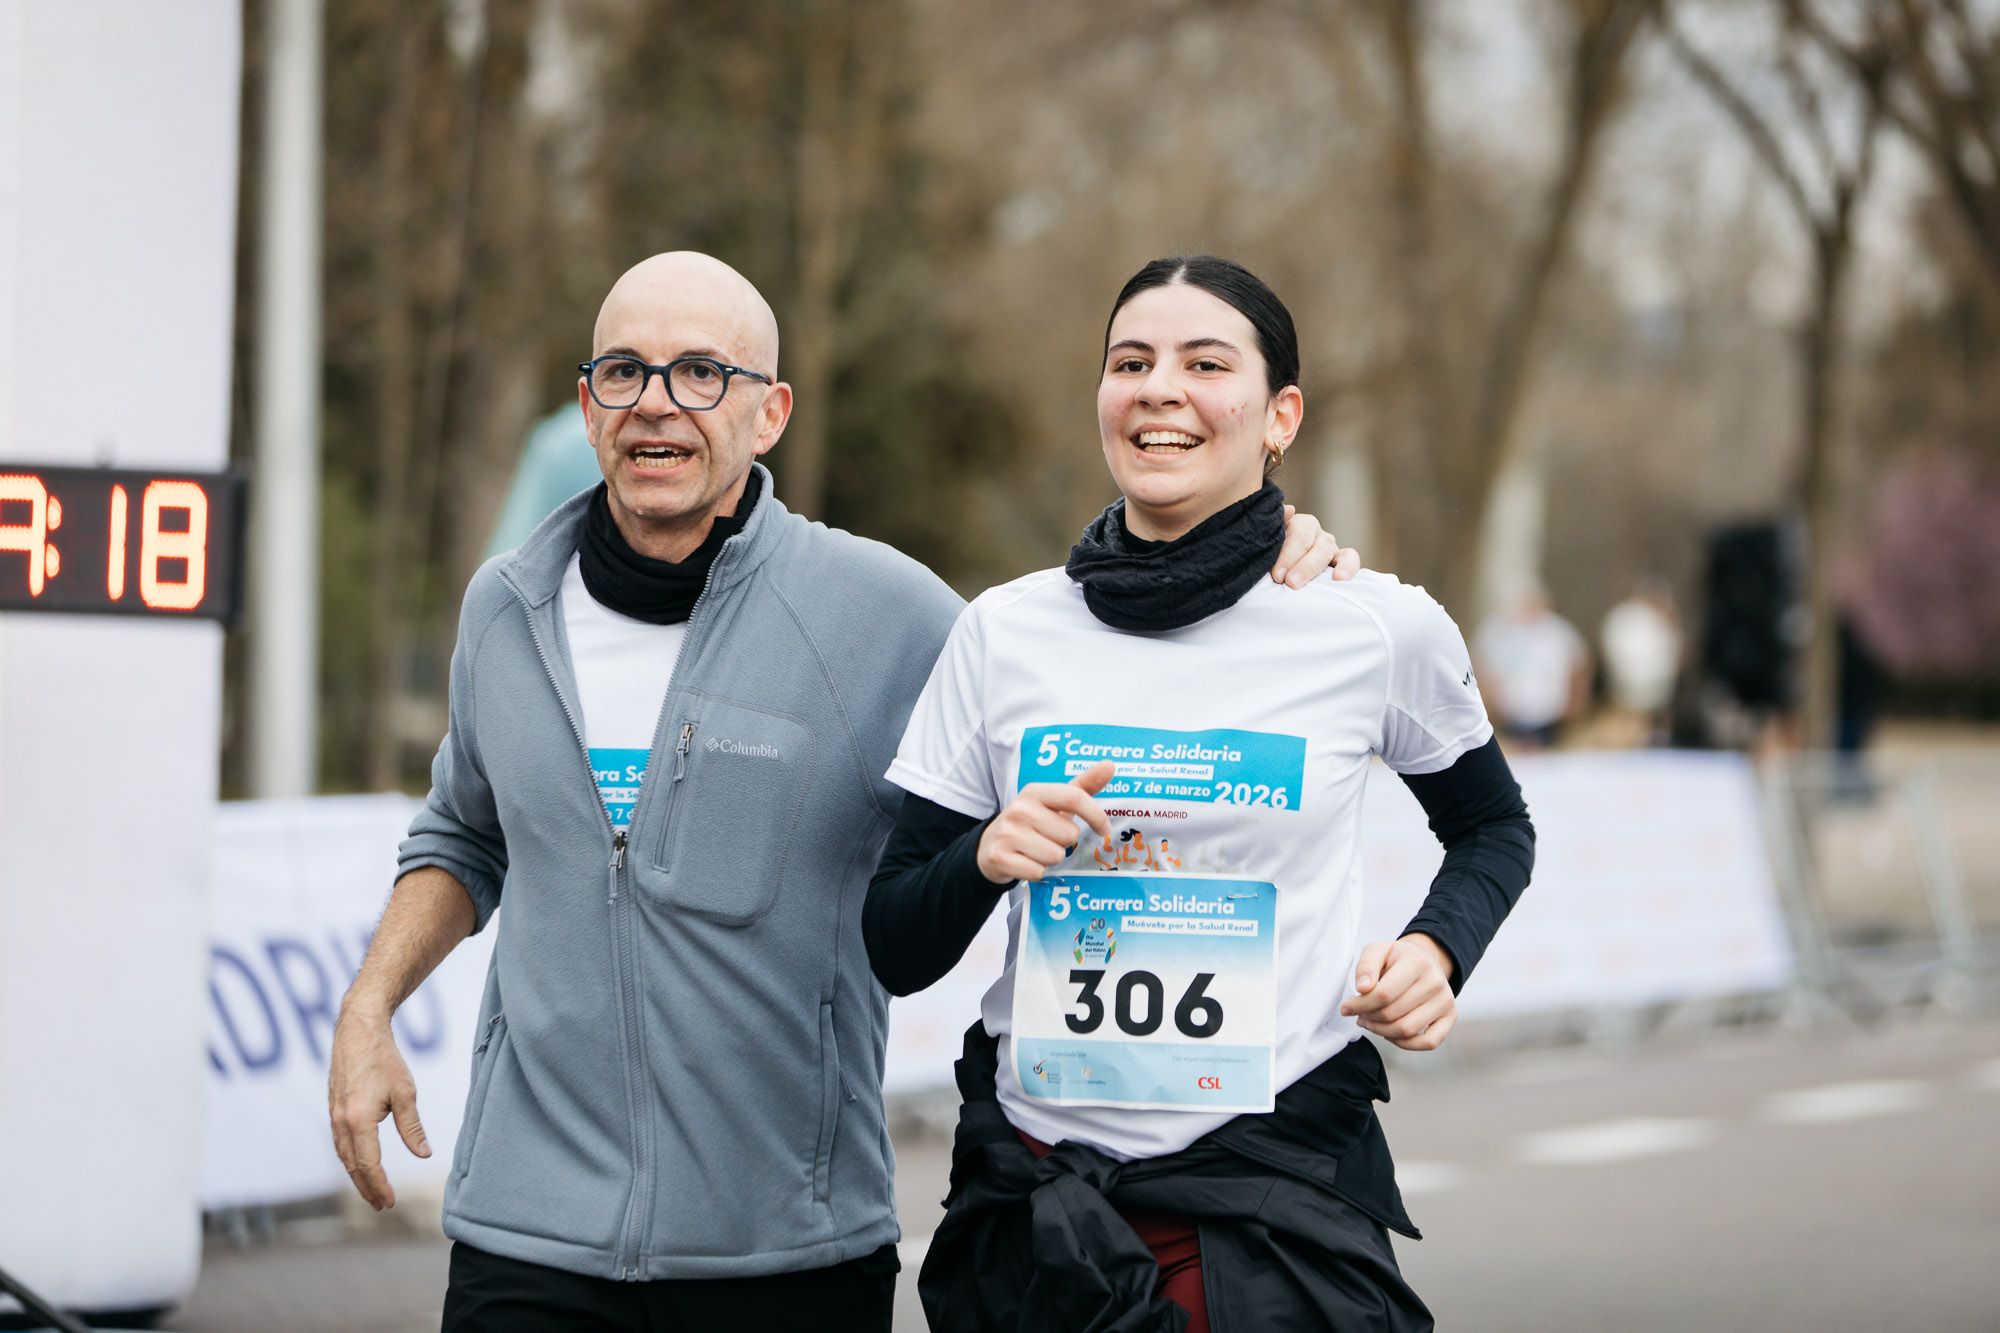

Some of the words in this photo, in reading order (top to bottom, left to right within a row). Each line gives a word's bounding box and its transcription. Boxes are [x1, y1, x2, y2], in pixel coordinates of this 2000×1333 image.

[720, 739, 778, 758] Columbia
[1064, 739, 1145, 759] Carrera
[1150, 743, 1242, 762] Solidaria
[1117, 766, 1134, 774] por
[1137, 766, 1147, 774] la
[1149, 766, 1178, 775] Salud
[1180, 767, 1209, 776] Renal
[1133, 782, 1143, 794] 7
[1144, 781, 1162, 794] de
[1165, 785, 1211, 797] marzo
[1214, 781, 1288, 810] 2026
[1153, 810, 1188, 819] MADRID
[1076, 893, 1144, 912] Carrera
[1149, 894, 1235, 915] Solidaria
[1168, 922, 1184, 931] por
[1186, 921, 1196, 930] la
[1199, 922, 1225, 931] Salud
[1227, 923, 1254, 932] Renal
[1065, 969, 1224, 1039] 306
[1198, 1076, 1223, 1090] CSL
